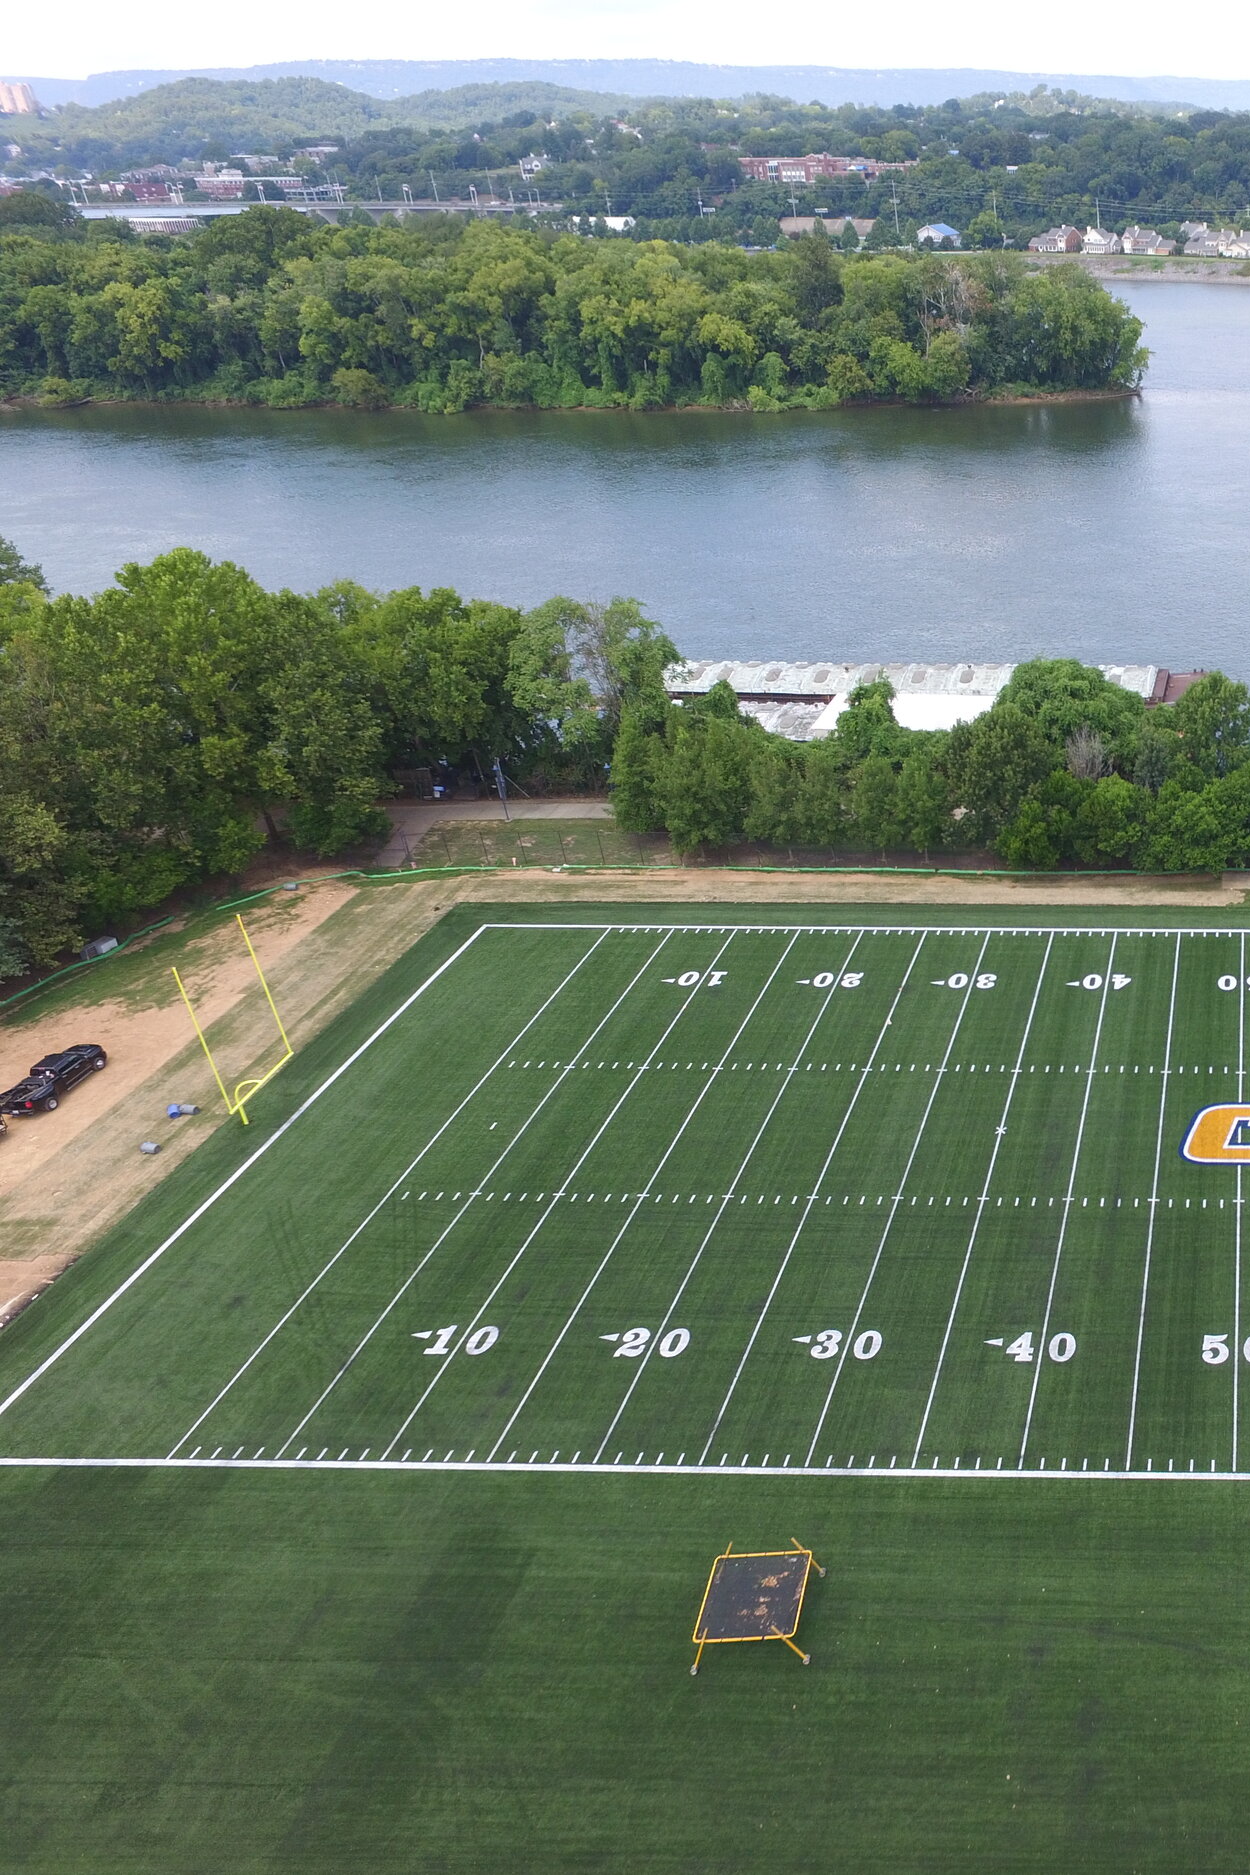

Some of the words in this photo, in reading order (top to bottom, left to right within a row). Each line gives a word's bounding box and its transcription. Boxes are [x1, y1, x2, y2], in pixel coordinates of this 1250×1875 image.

[677, 970, 729, 987] 10
[812, 971, 865, 988] 20
[947, 972, 998, 990] 30
[1082, 973, 1132, 990] 40
[422, 1324, 500, 1356] 10
[612, 1327, 691, 1358] 20
[810, 1329, 883, 1360] 30
[1005, 1331, 1077, 1363] 40
